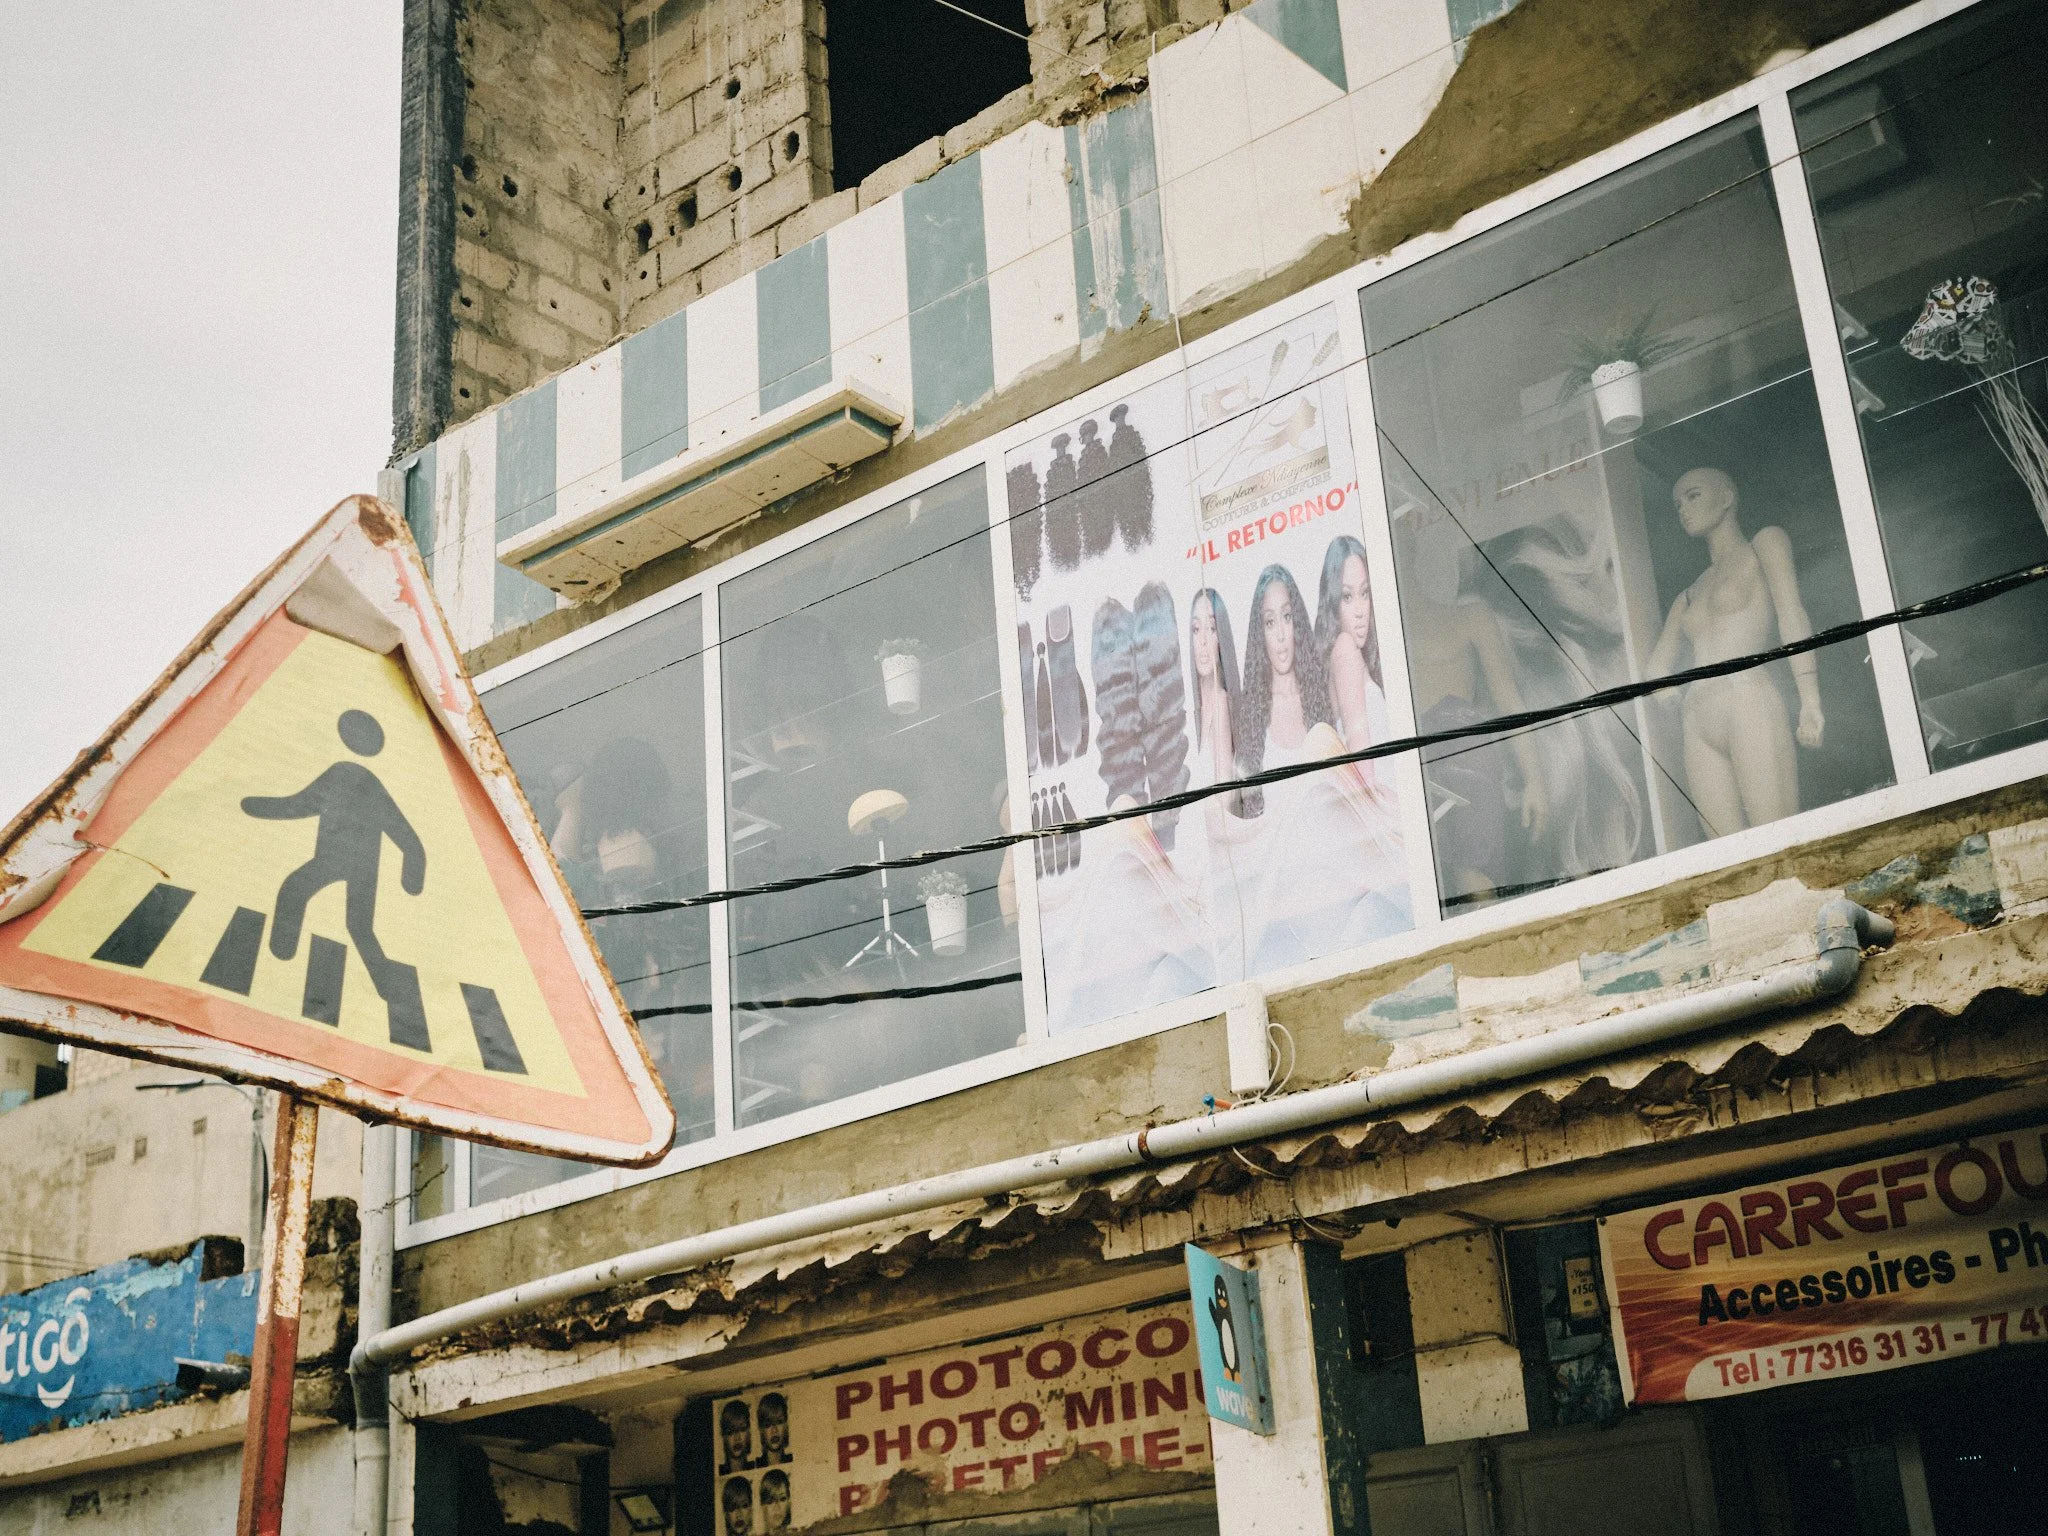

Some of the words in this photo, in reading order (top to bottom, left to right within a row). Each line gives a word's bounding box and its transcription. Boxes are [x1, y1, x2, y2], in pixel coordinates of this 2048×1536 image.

[1202, 484, 1259, 512] Complexe
[1202, 501, 1259, 531] COUTURE
[1260, 498, 1270, 508] &
[1271, 471, 1332, 503] COIFFURE
[1644, 1133, 2048, 1272] CARREFOU
[1700, 1249, 1956, 1327] Accessoires
[835, 1317, 1190, 1421] PHOTOCO
[1873, 1330, 1907, 1361] 31
[1912, 1323, 1948, 1355] 31
[1971, 1312, 2009, 1345] 77
[1215, 1385, 1256, 1422] wave
[836, 1402, 1041, 1473] PHOTO
